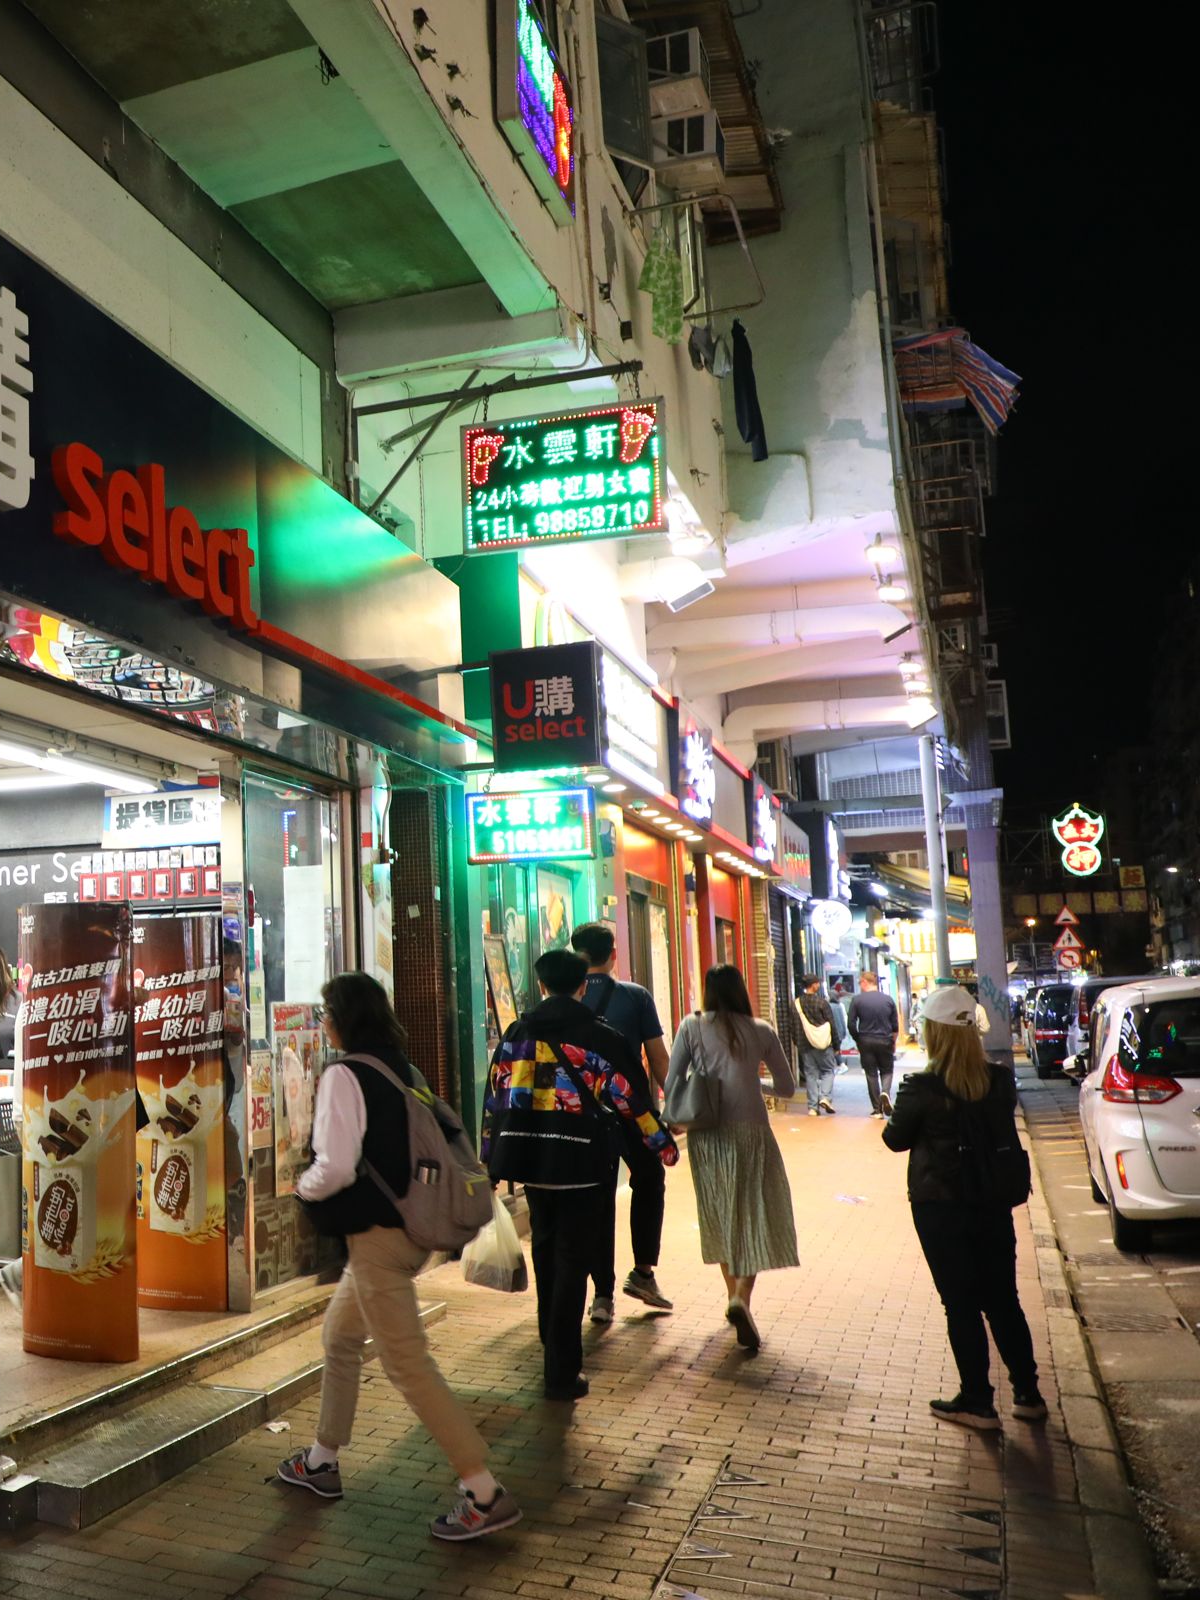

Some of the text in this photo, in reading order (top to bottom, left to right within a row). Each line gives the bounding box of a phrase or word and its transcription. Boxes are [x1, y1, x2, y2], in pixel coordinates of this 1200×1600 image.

[502, 424, 618, 469] 水雲軒
[51, 442, 260, 631] select
[533, 499, 649, 535] 98858710
[503, 675, 575, 719] U購
[504, 716, 587, 743] select
